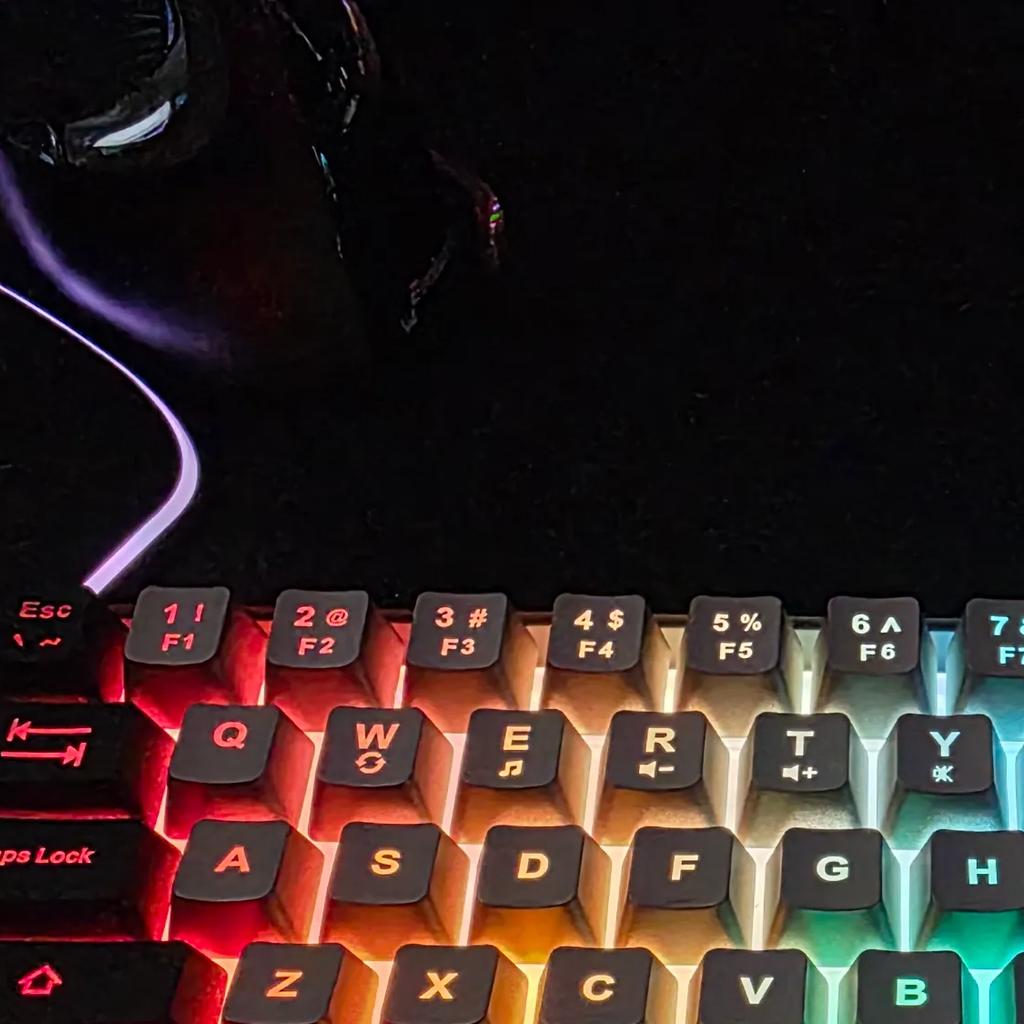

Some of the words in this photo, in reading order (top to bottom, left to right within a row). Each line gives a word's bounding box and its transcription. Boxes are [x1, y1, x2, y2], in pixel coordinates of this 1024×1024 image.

[19, 601, 72, 619] Esc
[164, 603, 178, 625] 1
[293, 606, 316, 627] 2
[435, 606, 455, 628] 3
[573, 609, 594, 631] 4
[712, 613, 730, 632] 5
[851, 613, 871, 635] 6
[990, 615, 1007, 636] 7
[161, 633, 194, 652] F1
[298, 636, 336, 656] F2
[440, 637, 475, 657] F3
[578, 640, 614, 659] F4
[719, 641, 753, 660] F5
[860, 643, 896, 662] F6
[213, 721, 248, 750] Q
[356, 723, 400, 750] W
[502, 725, 532, 751] E
[645, 727, 676, 753] R
[786, 730, 815, 757] T
[929, 731, 961, 758] Y
[0, 849, 31, 866] ps
[34, 847, 95, 865] Lock
[214, 845, 250, 873] A
[370, 848, 401, 876] S
[517, 852, 549, 880] D
[671, 854, 699, 881] F
[816, 855, 849, 882] G
[967, 858, 998, 885] H
[265, 969, 304, 998] Z
[418, 971, 459, 1000] X
[582, 974, 616, 1002] C
[739, 976, 775, 1005] V
[895, 978, 928, 1006] B
